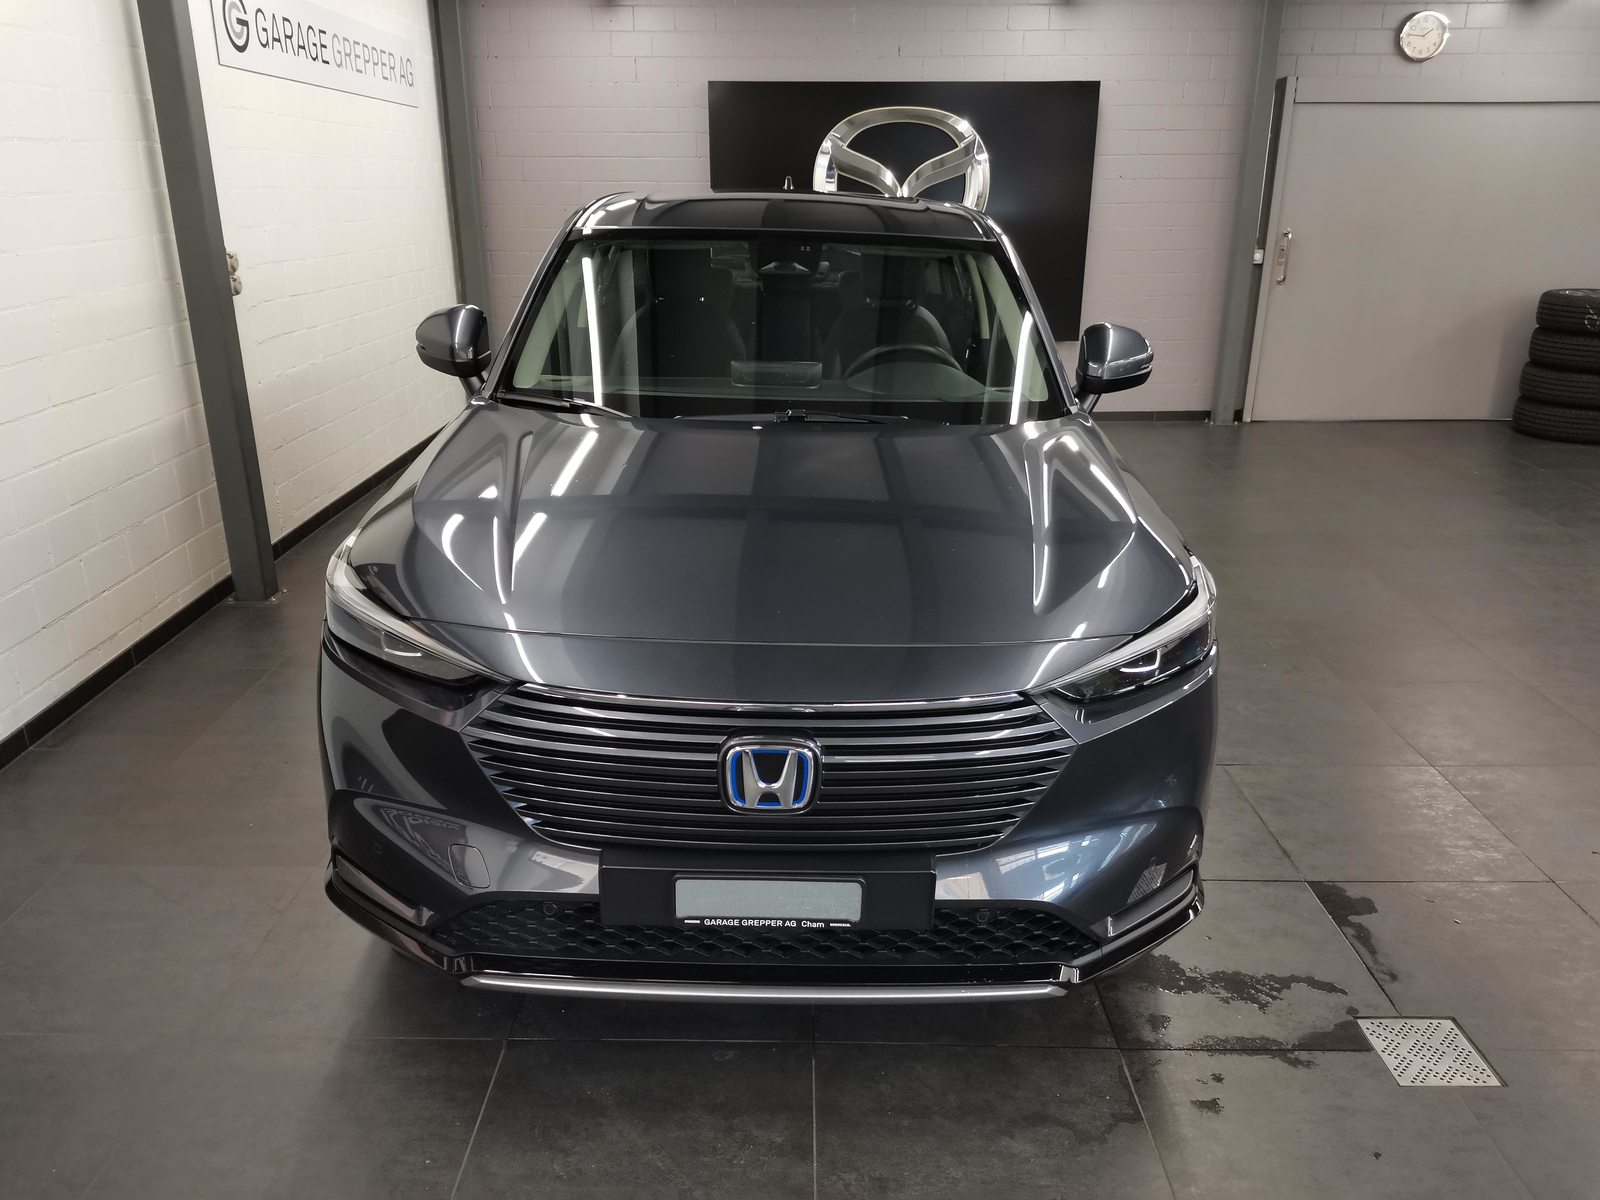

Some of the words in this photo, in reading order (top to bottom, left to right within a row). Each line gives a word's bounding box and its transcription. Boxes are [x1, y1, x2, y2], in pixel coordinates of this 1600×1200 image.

[255, 8, 330, 65] GARAGE
[331, 33, 398, 83] GREPPER
[399, 56, 415, 88] AG
[703, 918, 740, 926] GARAGE
[741, 919, 783, 927] GREPPER
[801, 920, 825, 928] Cham
